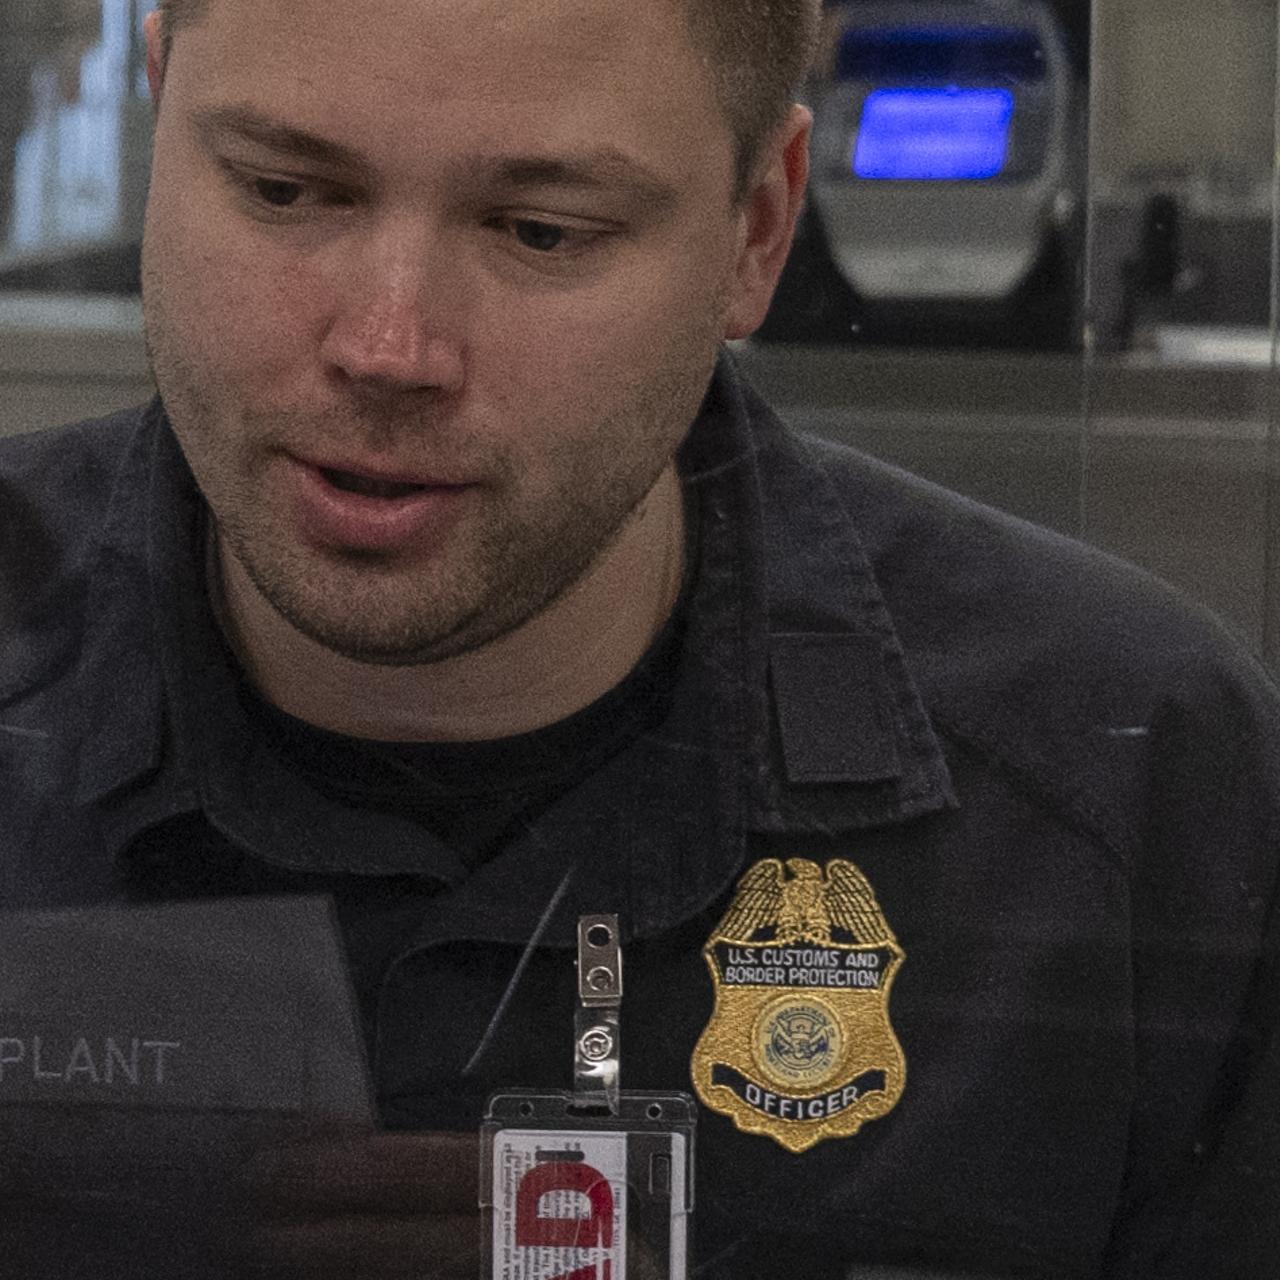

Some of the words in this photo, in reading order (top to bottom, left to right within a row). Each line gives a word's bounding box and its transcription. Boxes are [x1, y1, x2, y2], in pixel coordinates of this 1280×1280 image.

[727, 949, 759, 965] U.S.
[761, 949, 840, 967] CUSTOMS
[845, 951, 879, 968] AND
[725, 967, 785, 984] BORDER
[788, 968, 880, 986] PROTECTION
[744, 1083, 860, 1120] OFFICER
